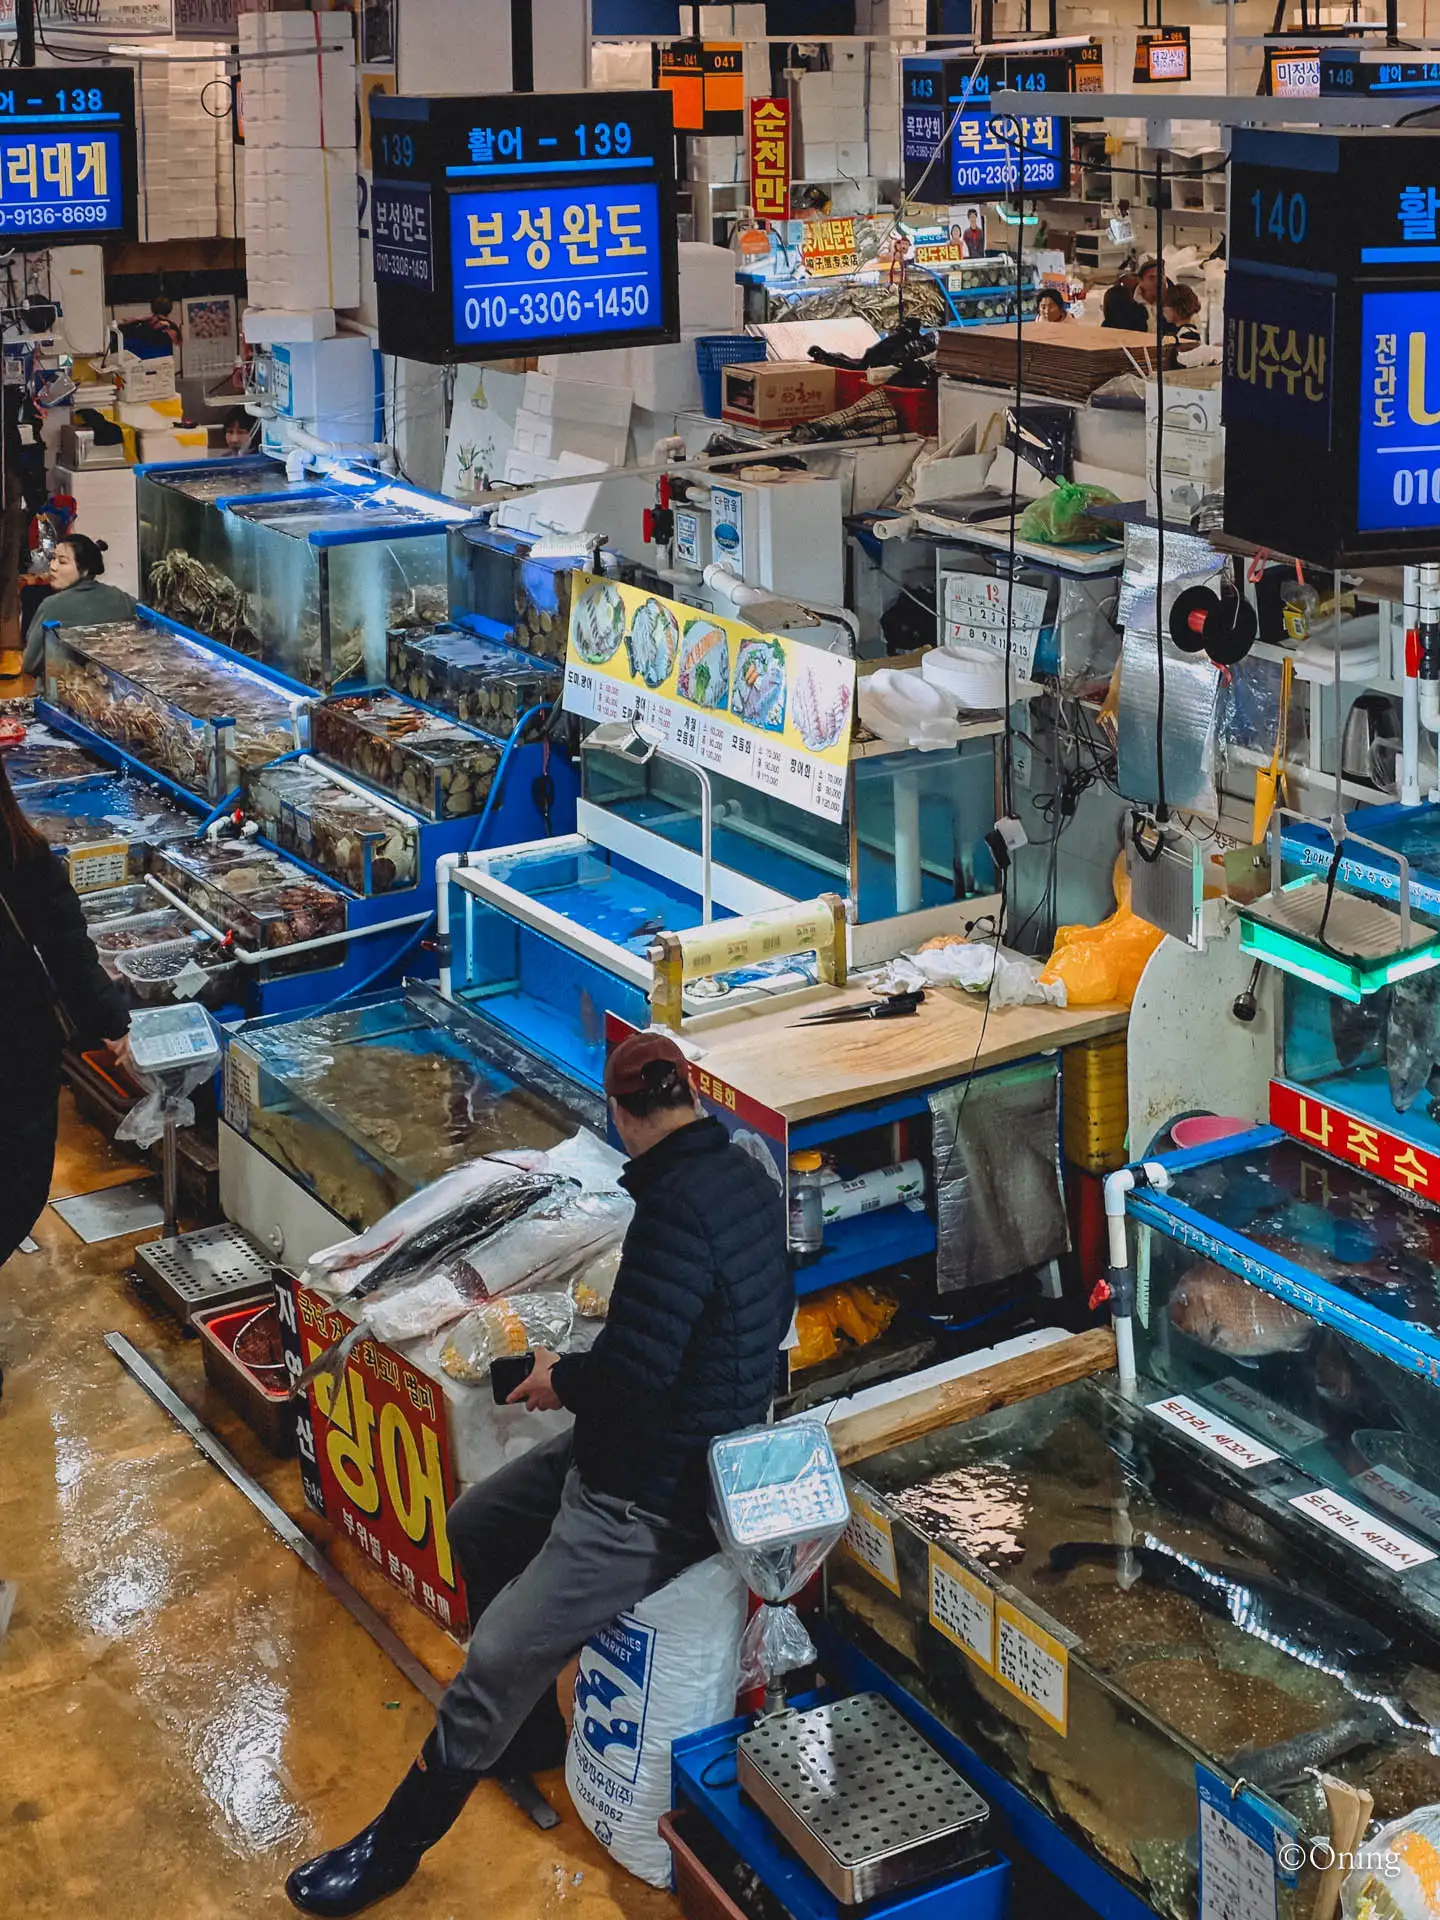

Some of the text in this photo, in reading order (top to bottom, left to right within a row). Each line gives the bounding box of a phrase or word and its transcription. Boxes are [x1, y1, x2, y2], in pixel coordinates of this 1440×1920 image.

[714, 55, 735, 68] 041
[1081, 48, 1098, 60] 042
[1423, 63, 1440, 80] 14
[910, 79, 933, 97] 143
[1015, 72, 1046, 93] 143
[1328, 68, 1353, 85] 148
[55, 87, 103, 113] 138
[467, 126, 523, 163] 활어
[574, 121, 633, 158] 139
[906, 115, 941, 140] 목포상회
[958, 116, 1054, 155] 목포상회
[381, 133, 415, 168] 139
[753, 102, 788, 214] 순천만
[0, 141, 108, 198] 리대게
[957, 162, 1055, 187] 010-2360-2258
[375, 201, 428, 243] 보성완도
[1251, 188, 1308, 244] 140
[464, 203, 648, 271] 보성완도
[916, 245, 962, 264] 완도전복
[375, 252, 429, 281] 010-3306-1450
[463, 284, 650, 331] 010-3306-1450
[1236, 319, 1328, 402] 나주수산
[1372, 333, 1397, 428] 전라도
[985, 583, 1000, 604] 12
[968, 607, 973, 617] 1
[980, 609, 987, 620] 2
[991, 612, 997, 623] 3
[1011, 618, 1017, 630] 5
[954, 625, 961, 637] 7
[968, 628, 976, 639] 8
[982, 631, 988, 641] 9
[999, 638, 1006, 650] 11
[1019, 646, 1028, 657] 13
[731, 735, 751, 755] 모듬회
[699, 1072, 736, 1112] 모듬회
[1299, 1097, 1429, 1190] 나주수
[275, 1283, 317, 1464] 자연산
[362, 1340, 401, 1392] 최고!
[402, 1370, 436, 1423] 별미
[307, 1337, 456, 1591] 방어
[1211, 1432, 1263, 1465] 세꼬시
[1359, 1530, 1419, 1565] 세꼬시
[342, 1507, 383, 1565] 부위별
[421, 1580, 452, 1627] 판매
[600, 1631, 632, 1663] MARKET
